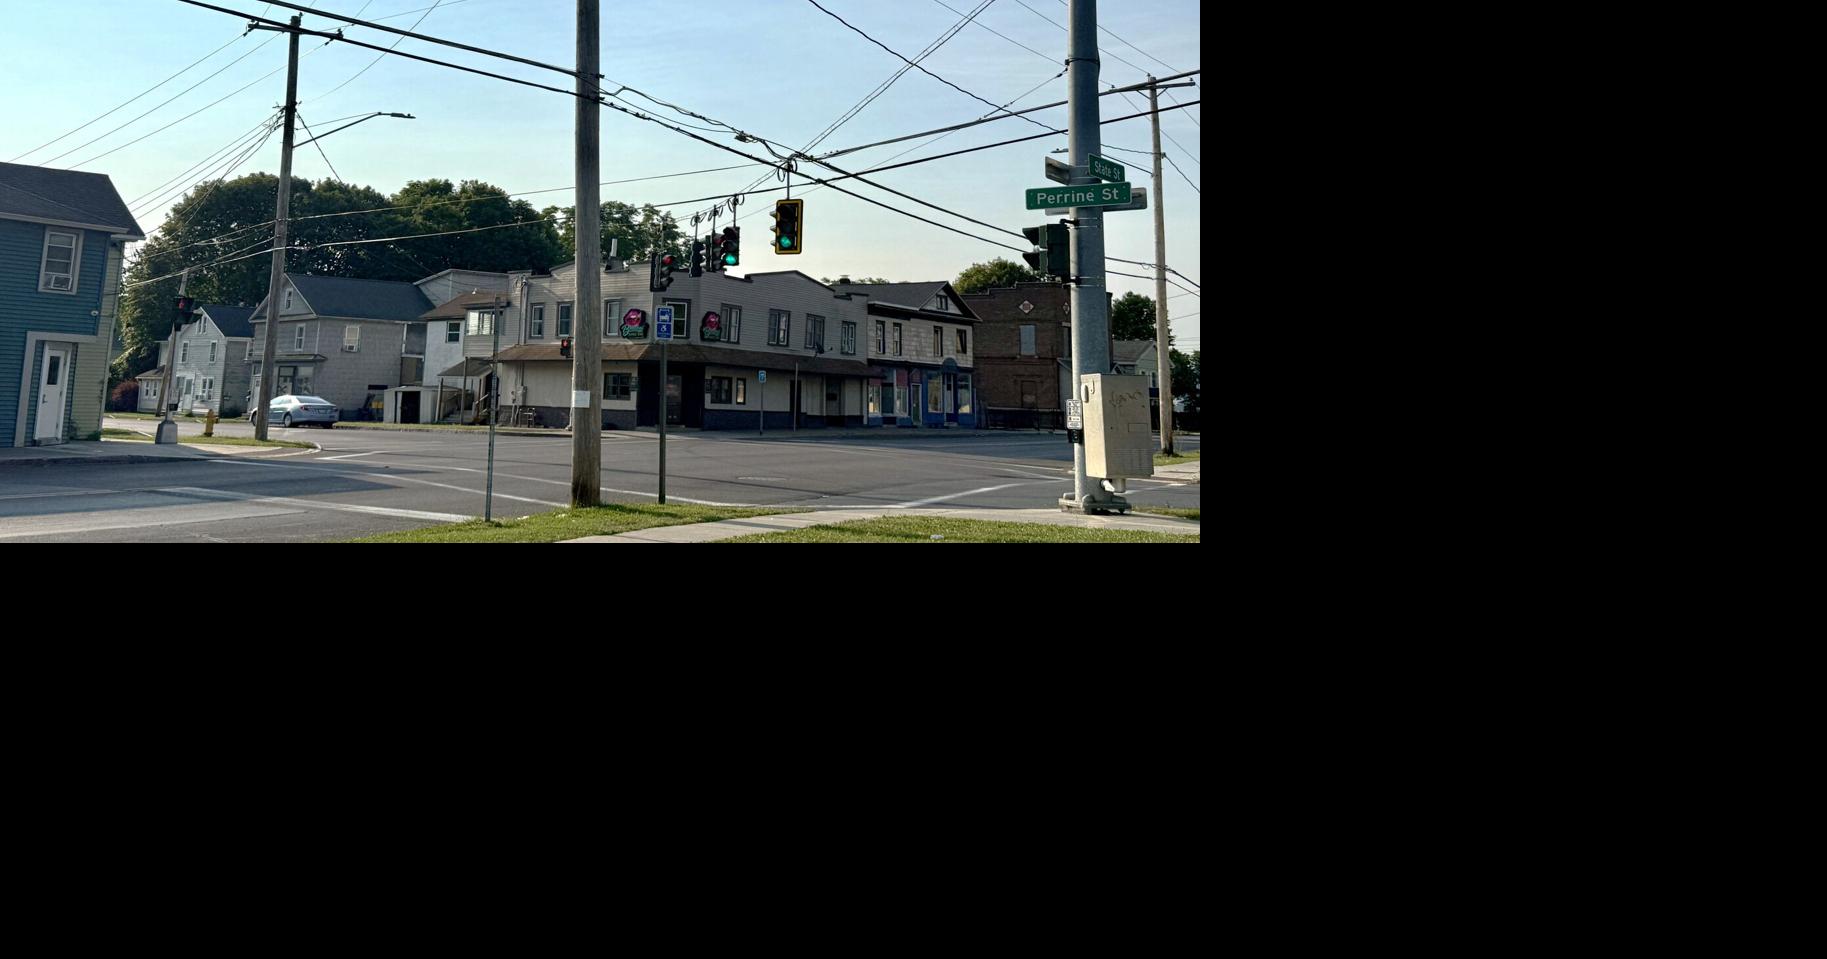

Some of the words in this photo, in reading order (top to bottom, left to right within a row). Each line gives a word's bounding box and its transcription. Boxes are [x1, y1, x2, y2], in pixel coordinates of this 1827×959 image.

[1094, 161, 1111, 177] State
[1113, 168, 1121, 180] St
[1037, 190, 1095, 204] Perrine
[1102, 187, 1119, 200] St
